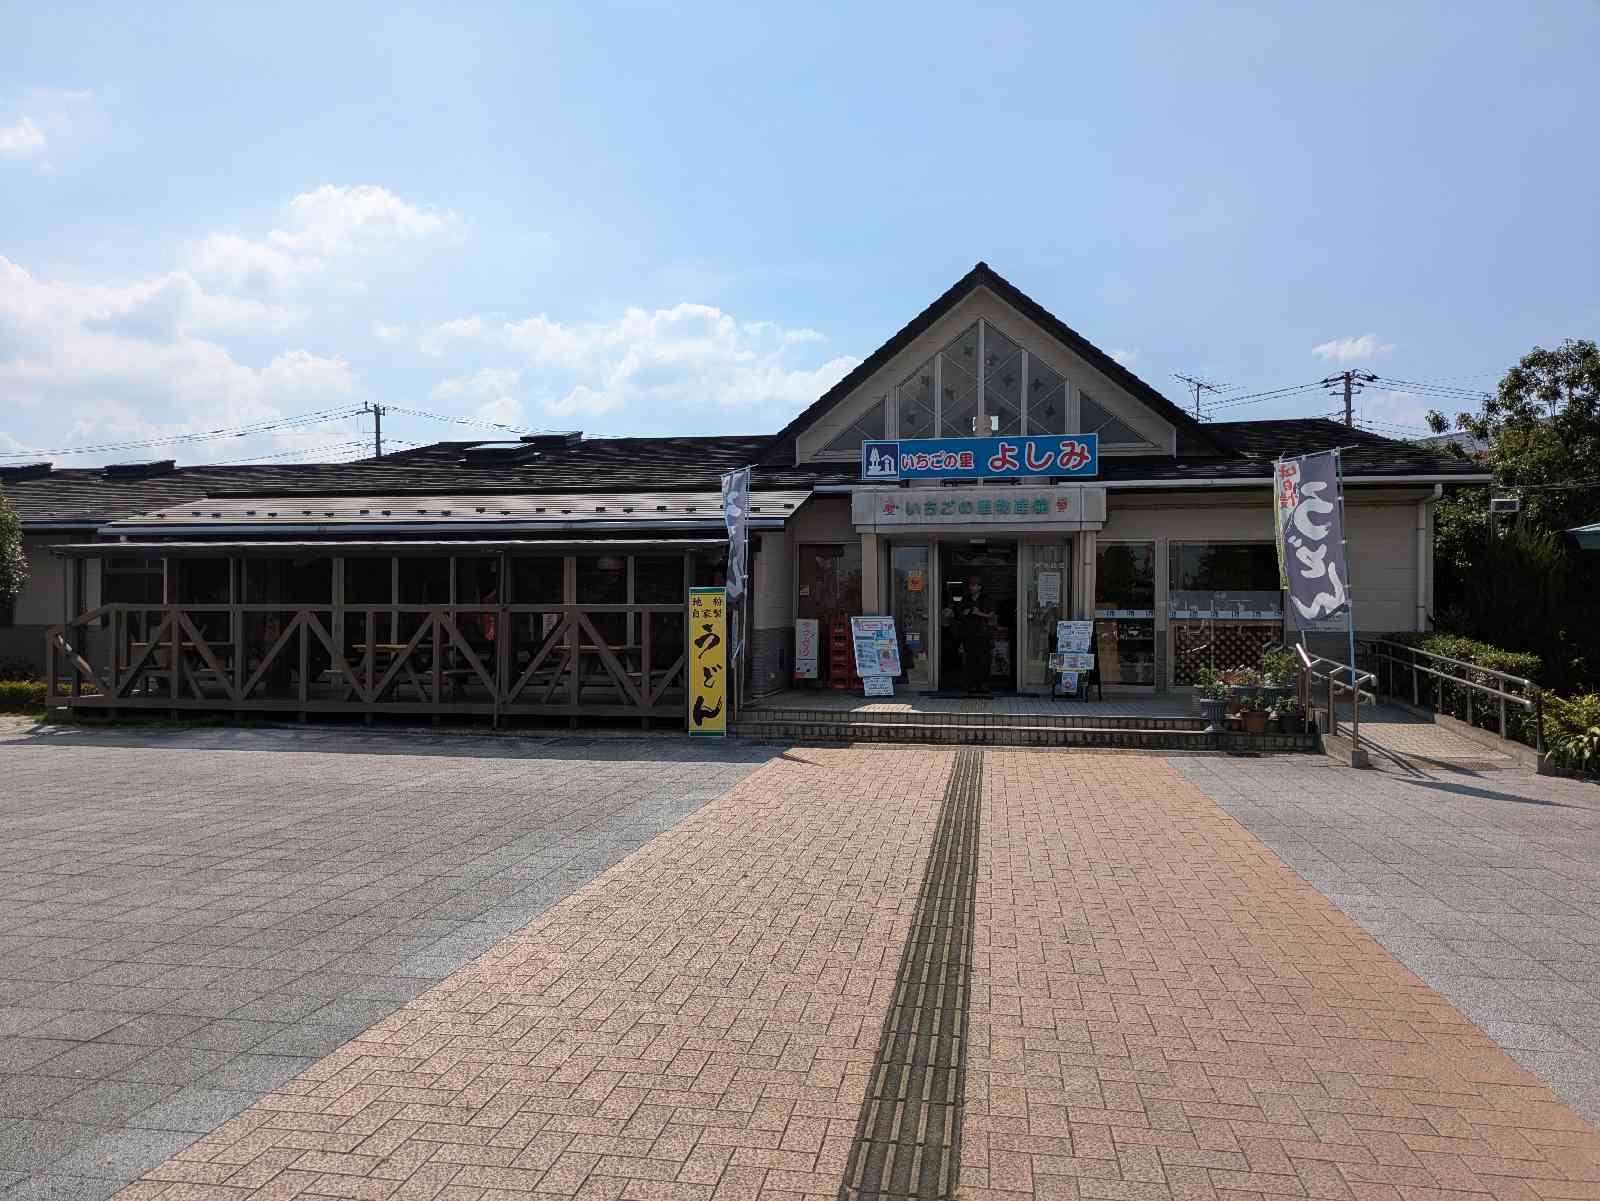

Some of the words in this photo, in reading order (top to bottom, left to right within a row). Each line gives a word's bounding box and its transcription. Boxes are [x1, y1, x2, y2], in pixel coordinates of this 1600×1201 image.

[901, 451, 974, 471] いちごの里
[988, 440, 1091, 472] よしみ
[693, 623, 723, 727] うどん
